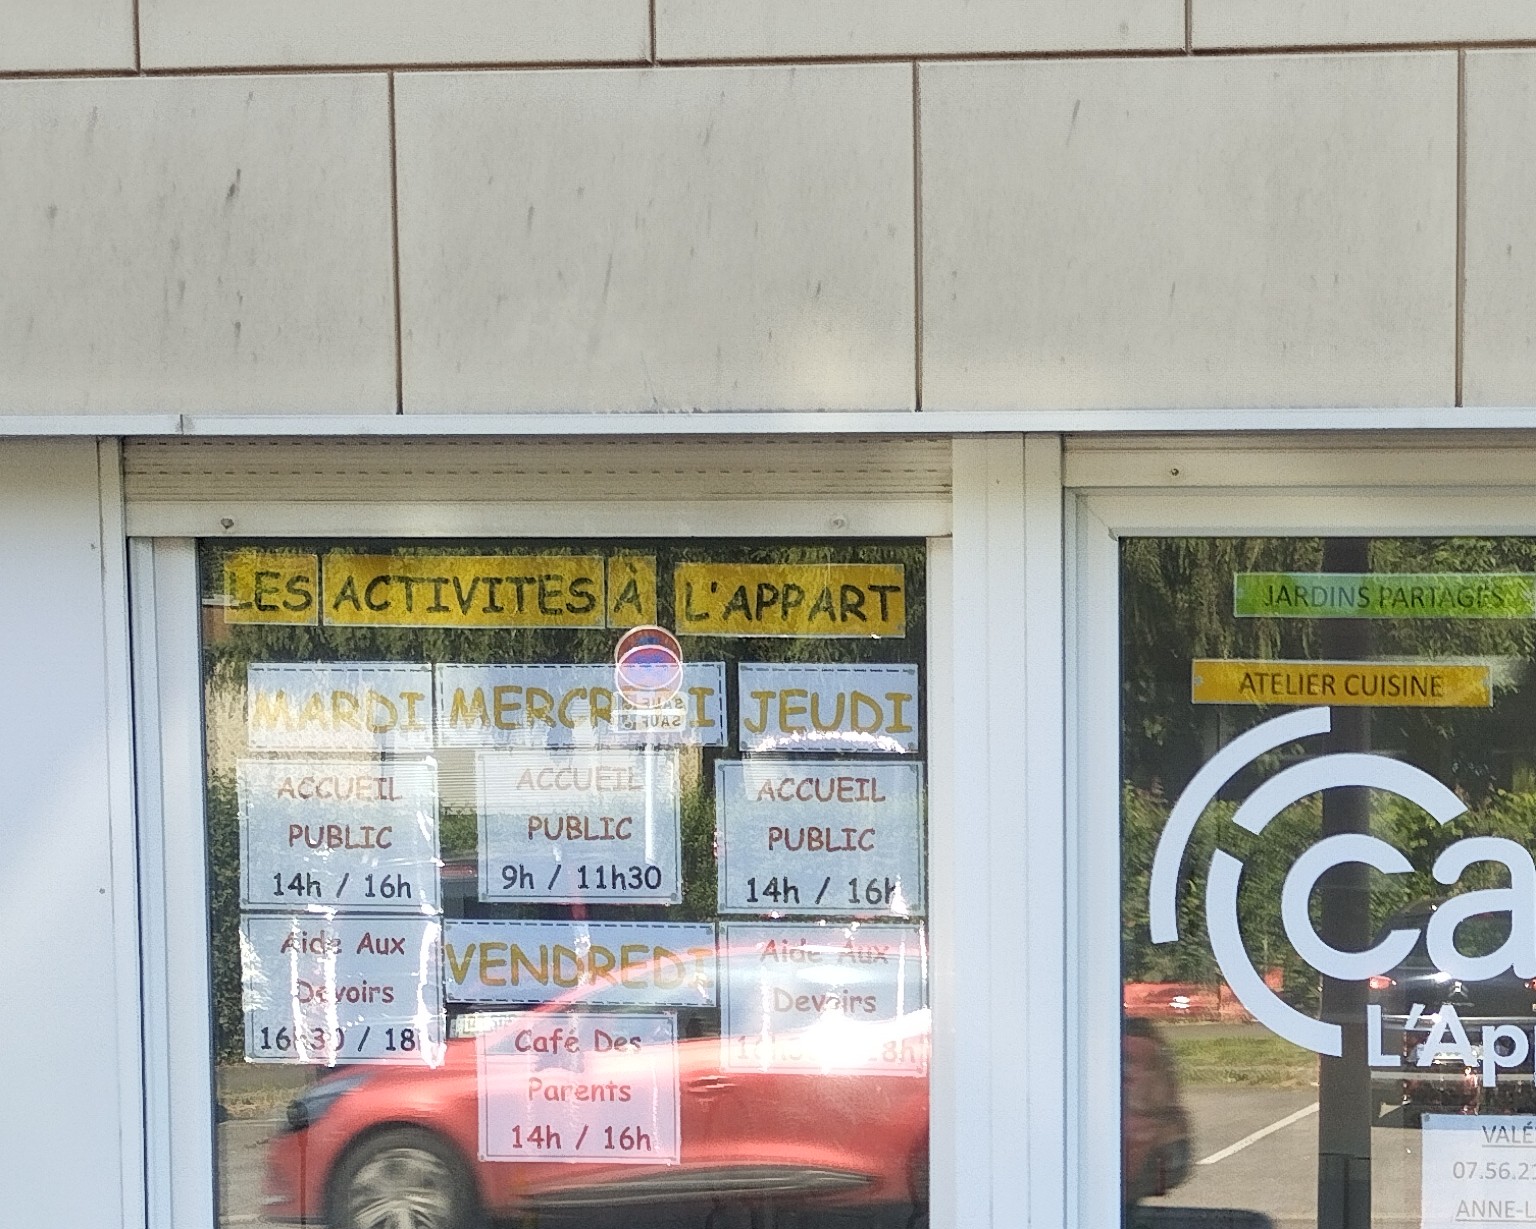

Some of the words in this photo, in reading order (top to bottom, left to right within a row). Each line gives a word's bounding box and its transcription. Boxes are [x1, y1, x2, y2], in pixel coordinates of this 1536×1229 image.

[226, 570, 312, 612] LES
[331, 573, 598, 615] ACTIVITES
[613, 562, 643, 616] À
[685, 580, 901, 624] L'APPART
[1264, 585, 1370, 609] JARDINS
[1238, 671, 1335, 697] ATELIER
[1344, 674, 1444, 699] CUISINE
[254, 688, 426, 733] MARDI
[743, 688, 913, 734] JEUDI
[277, 776, 403, 801] ACCUEIL
[516, 767, 646, 793] ACCUEIL
[757, 776, 886, 803] ACCUEIL
[288, 824, 393, 850] PUBLIC
[528, 814, 634, 841] PUBLIC
[768, 826, 876, 852] PUBLIC
[273, 872, 322, 898] 14h
[335, 872, 350, 898] /
[365, 873, 412, 899] 16h
[501, 863, 535, 890] 9h
[547, 864, 562, 890] /
[577, 864, 663, 891] 11h30
[747, 876, 801, 904] 14h
[814, 876, 831, 904] /
[356, 931, 406, 956] Aux
[445, 941, 715, 989] VENDREDI
[260, 1026, 345, 1051] 1630
[357, 1026, 371, 1052] /
[514, 1028, 581, 1054] Café
[593, 1030, 642, 1054] Des
[528, 1076, 632, 1102] Parents
[511, 1124, 562, 1150] 14h
[575, 1125, 589, 1150] /
[603, 1126, 652, 1151] 16h
